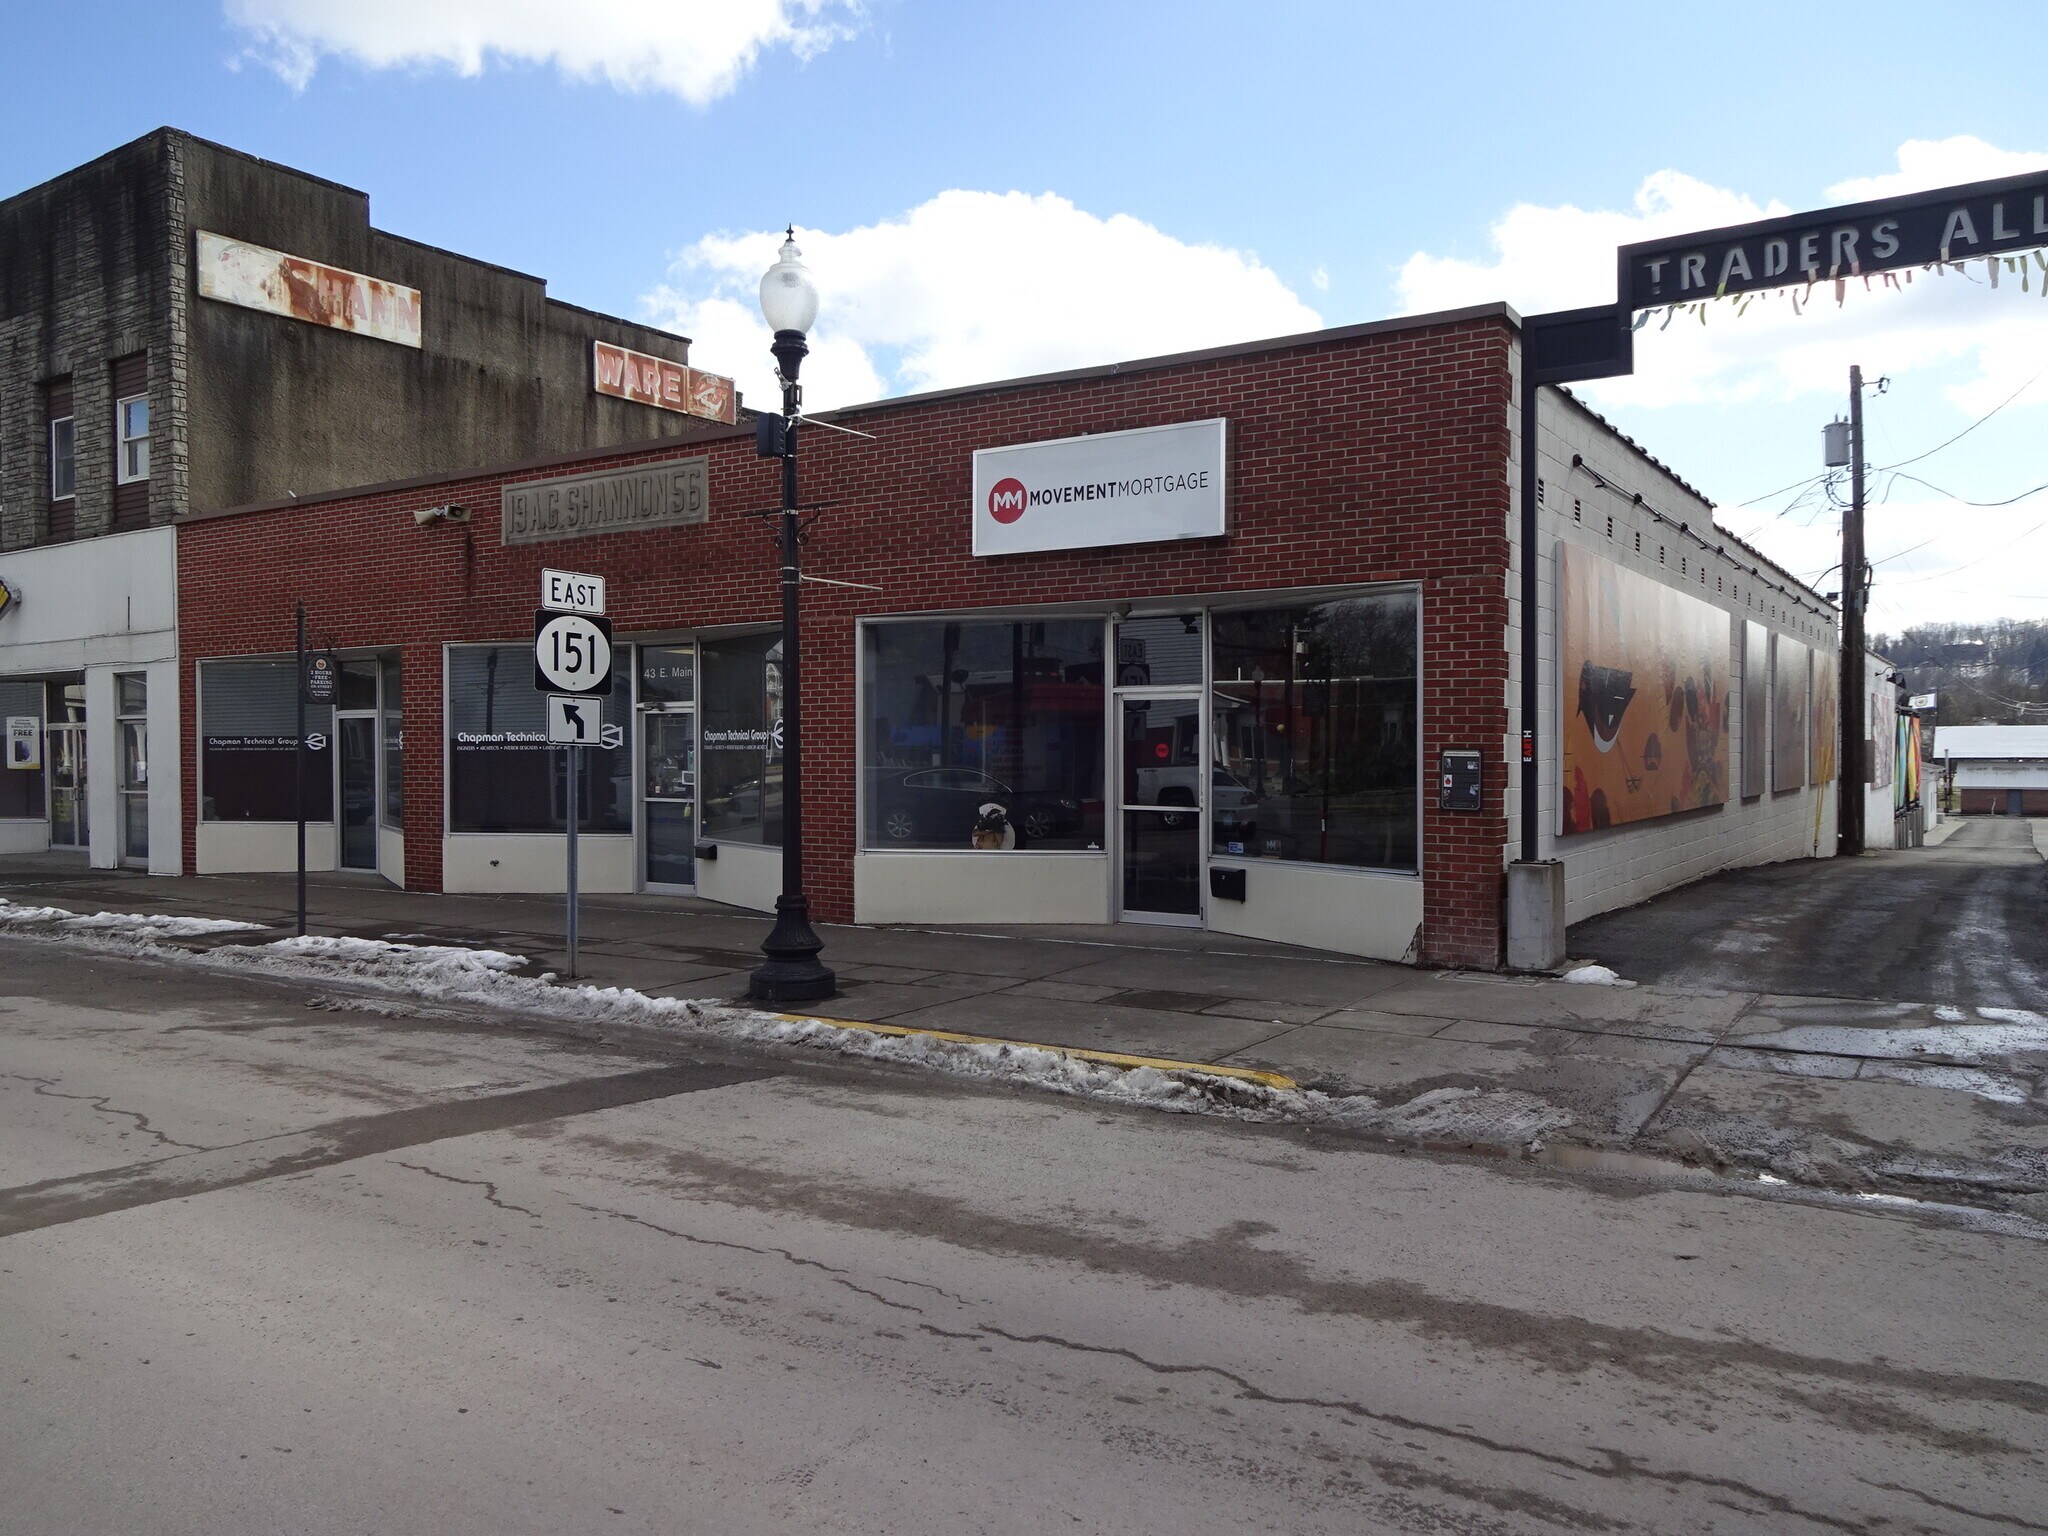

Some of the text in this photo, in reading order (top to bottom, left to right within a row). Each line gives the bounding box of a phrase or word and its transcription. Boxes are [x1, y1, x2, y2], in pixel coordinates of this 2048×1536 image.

[1643, 219, 1901, 296] TRADERS
[596, 350, 682, 403] WARE
[508, 494, 528, 534] 19
[566, 472, 668, 526] SHANNON
[671, 469, 702, 514] 56
[551, 577, 596, 607] EAST
[551, 630, 596, 675] 151
[644, 666, 693, 679] 43 E. Main
[13, 729, 33, 737] FREE
[209, 737, 299, 747] Chapman Technical Group
[457, 731, 546, 745] Chapman Technica
[704, 729, 767, 743] Chapman Technical Group
[1523, 730, 1532, 762] EARTH
